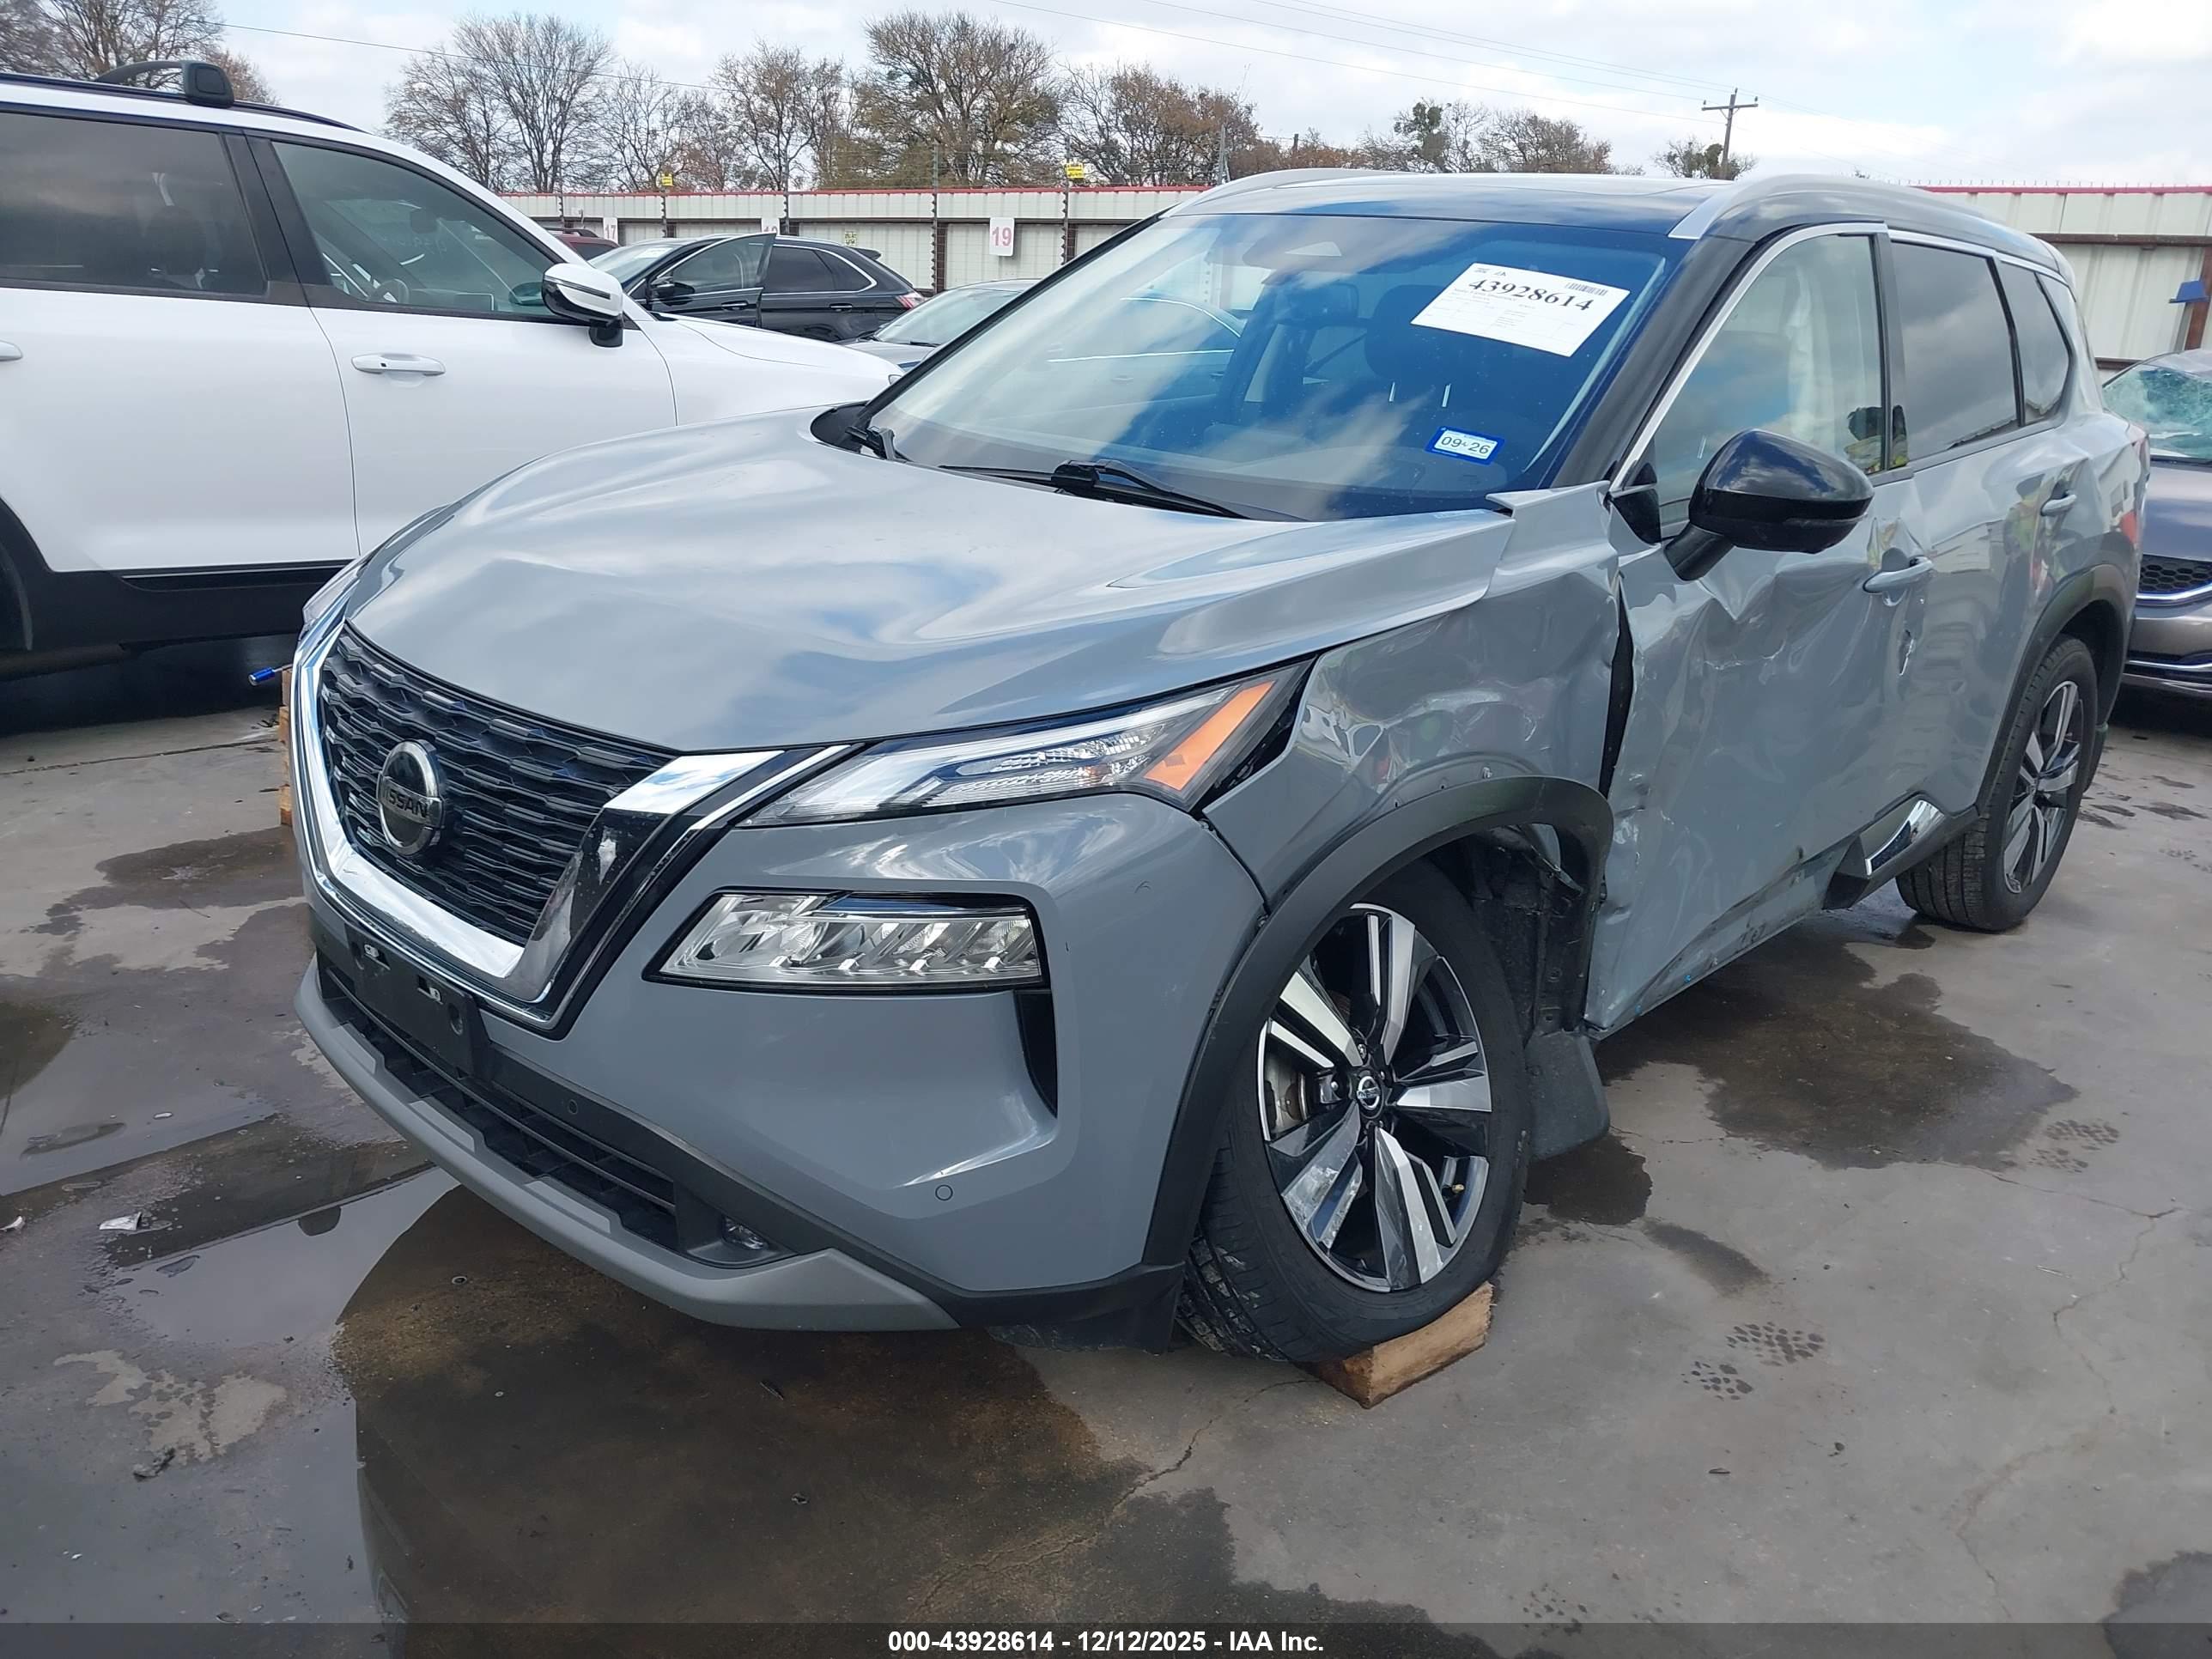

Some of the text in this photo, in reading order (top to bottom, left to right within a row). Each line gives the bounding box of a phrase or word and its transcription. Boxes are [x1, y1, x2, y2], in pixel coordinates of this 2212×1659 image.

[992, 226, 1012, 246] 19
[1468, 279, 1595, 311] 43928614
[1441, 436, 1462, 447] 09
[1468, 442, 1491, 454] 26
